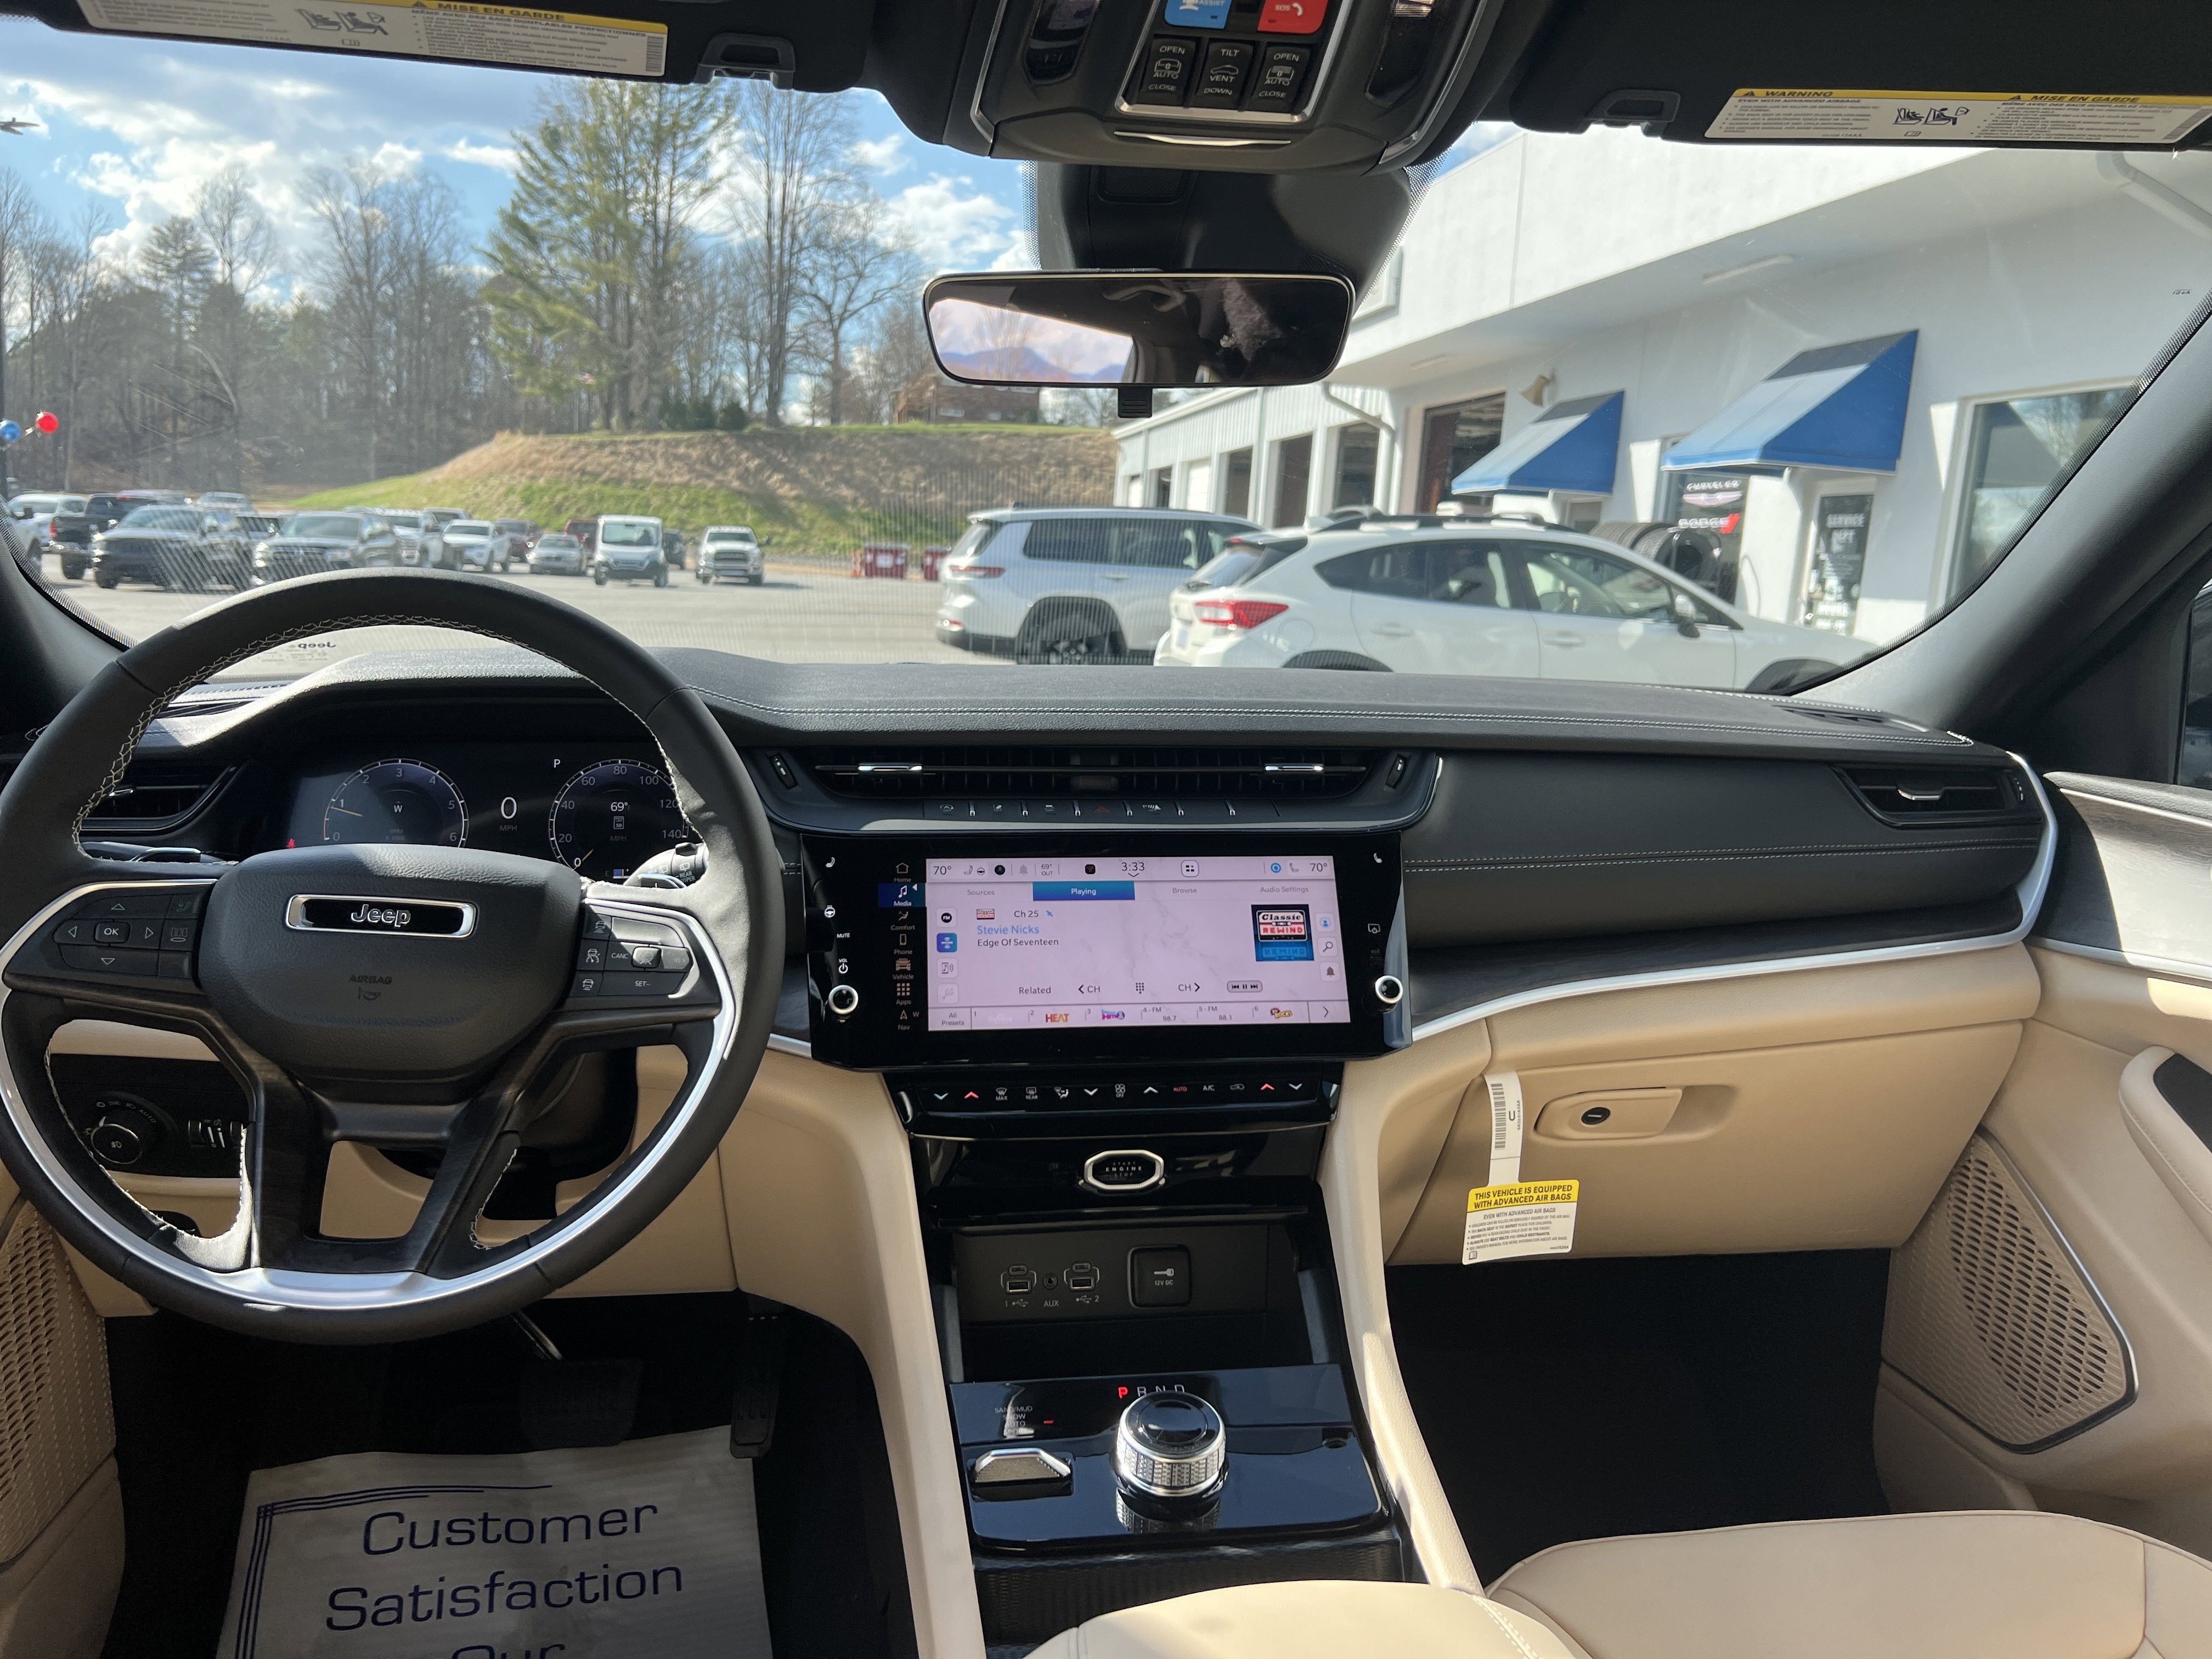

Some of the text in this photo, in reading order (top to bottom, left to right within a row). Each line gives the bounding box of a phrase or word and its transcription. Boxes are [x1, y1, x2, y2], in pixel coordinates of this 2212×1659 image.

[438, 3, 478, 12] MISE
[510, 10, 565, 20] GARDE
[1160, 46, 1185, 54] OPEN
[1221, 49, 1240, 57] TILT
[1273, 53, 1299, 62] OPEN
[1679, 517, 1729, 528] DODGE
[554, 759, 561, 768] P
[396, 768, 403, 777] 3
[613, 766, 627, 775] 80
[363, 775, 370, 784] 2
[429, 776, 436, 785] 4
[582, 776, 595, 786] 60
[640, 776, 659, 785] 100
[340, 799, 344, 808] 1
[448, 800, 455, 809] 5
[501, 797, 517, 819] 0
[561, 800, 575, 809] 40
[660, 799, 679, 808] 120
[394, 805, 403, 813] W
[333, 832, 340, 841] 0
[450, 832, 457, 842] 6
[558, 833, 572, 843] 20
[663, 830, 682, 839] 140
[574, 857, 582, 867] 0
[1122, 862, 1145, 871] 3:33
[933, 865, 952, 875] 70°
[1310, 862, 1328, 872] 70°
[1071, 888, 1097, 896] Playing
[351, 904, 411, 927] Jeep
[104, 928, 119, 936] OK
[977, 925, 1040, 934] Stevie Nicks
[978, 939, 999, 947] Edge
[349, 974, 393, 985] AIRBAG
[1019, 986, 1051, 995] Related
[1045, 1013, 1069, 1023] HEAT
[1475, 1192, 1491, 1200] THIS
[1492, 1188, 1522, 1198] VEHICLE
[1533, 1185, 1572, 1193] EQUIPPED
[1474, 1200, 1492, 1209] WITH
[1494, 1195, 1533, 1206] ADVANCED
[1118, 1386, 1128, 1399] P
[1137, 1386, 1147, 1397] R
[363, 1503, 658, 1555] Customer
[326, 1563, 682, 1630] Satisfaction
